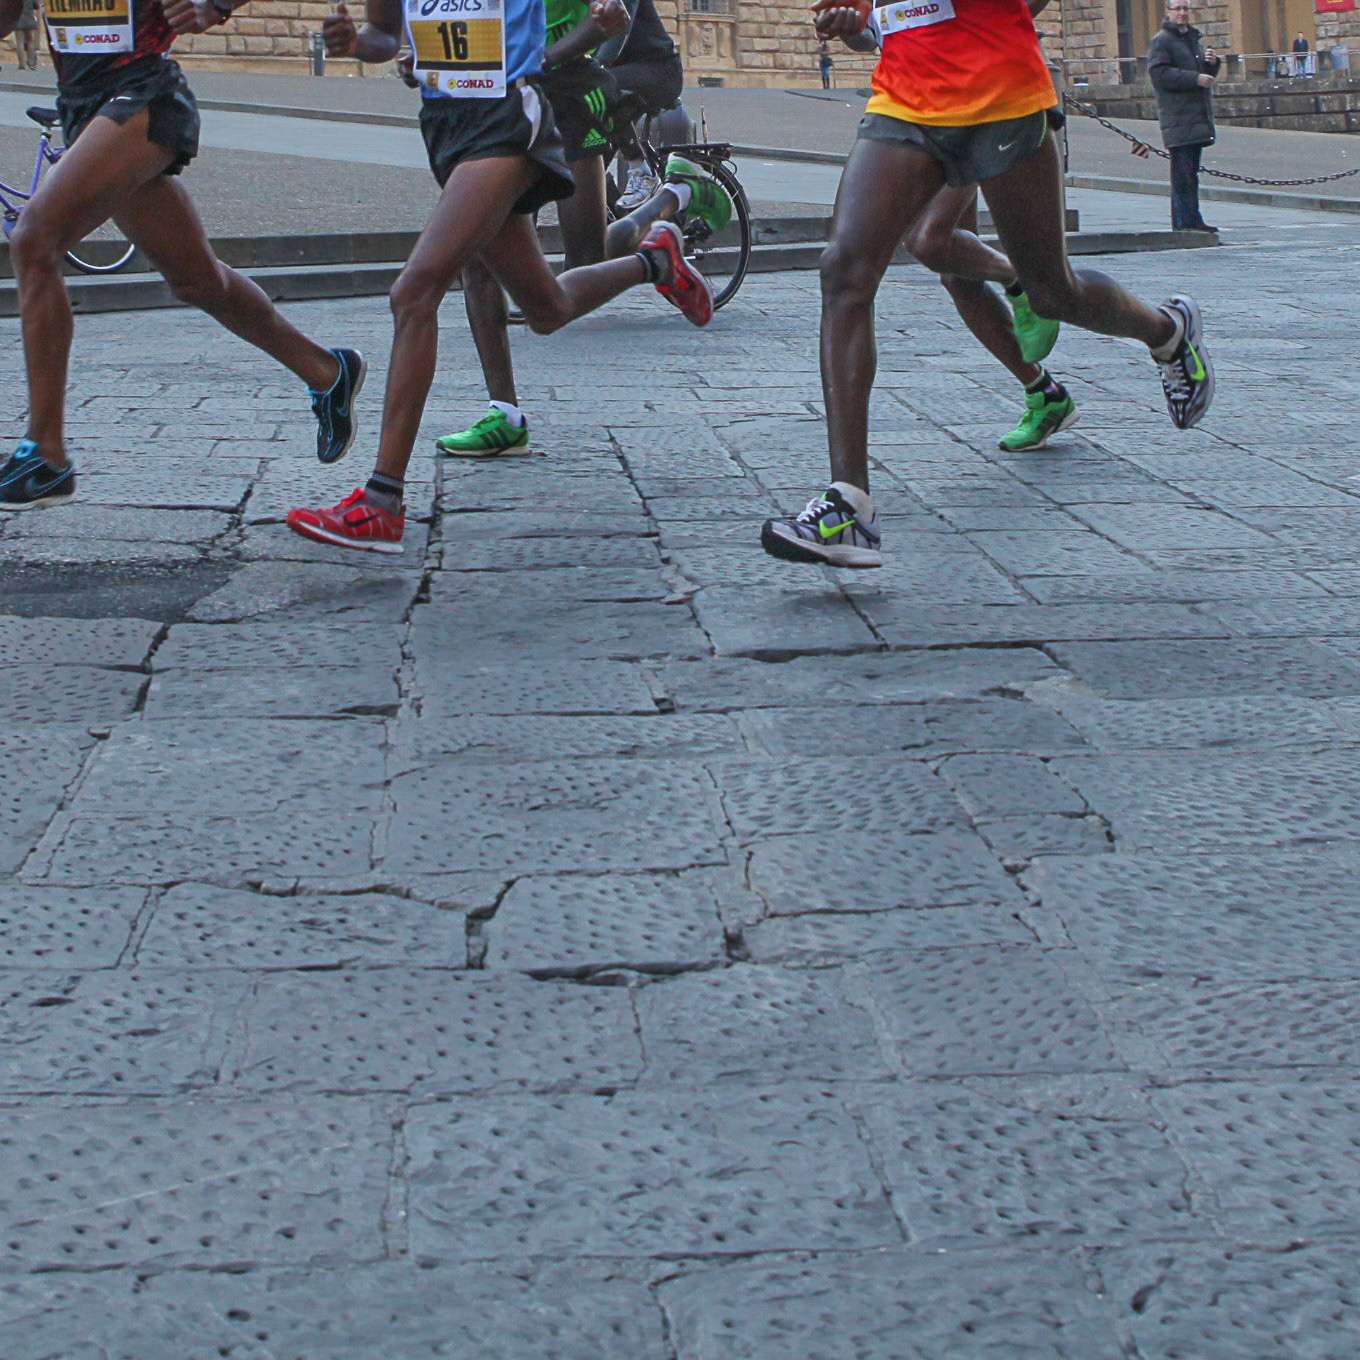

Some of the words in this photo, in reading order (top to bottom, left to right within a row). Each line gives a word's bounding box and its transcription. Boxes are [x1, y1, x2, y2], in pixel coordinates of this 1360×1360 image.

[904, 3, 940, 18] CONAD
[83, 33, 120, 44] CONAD
[437, 21, 469, 60] 16
[456, 79, 494, 89] CONAD
